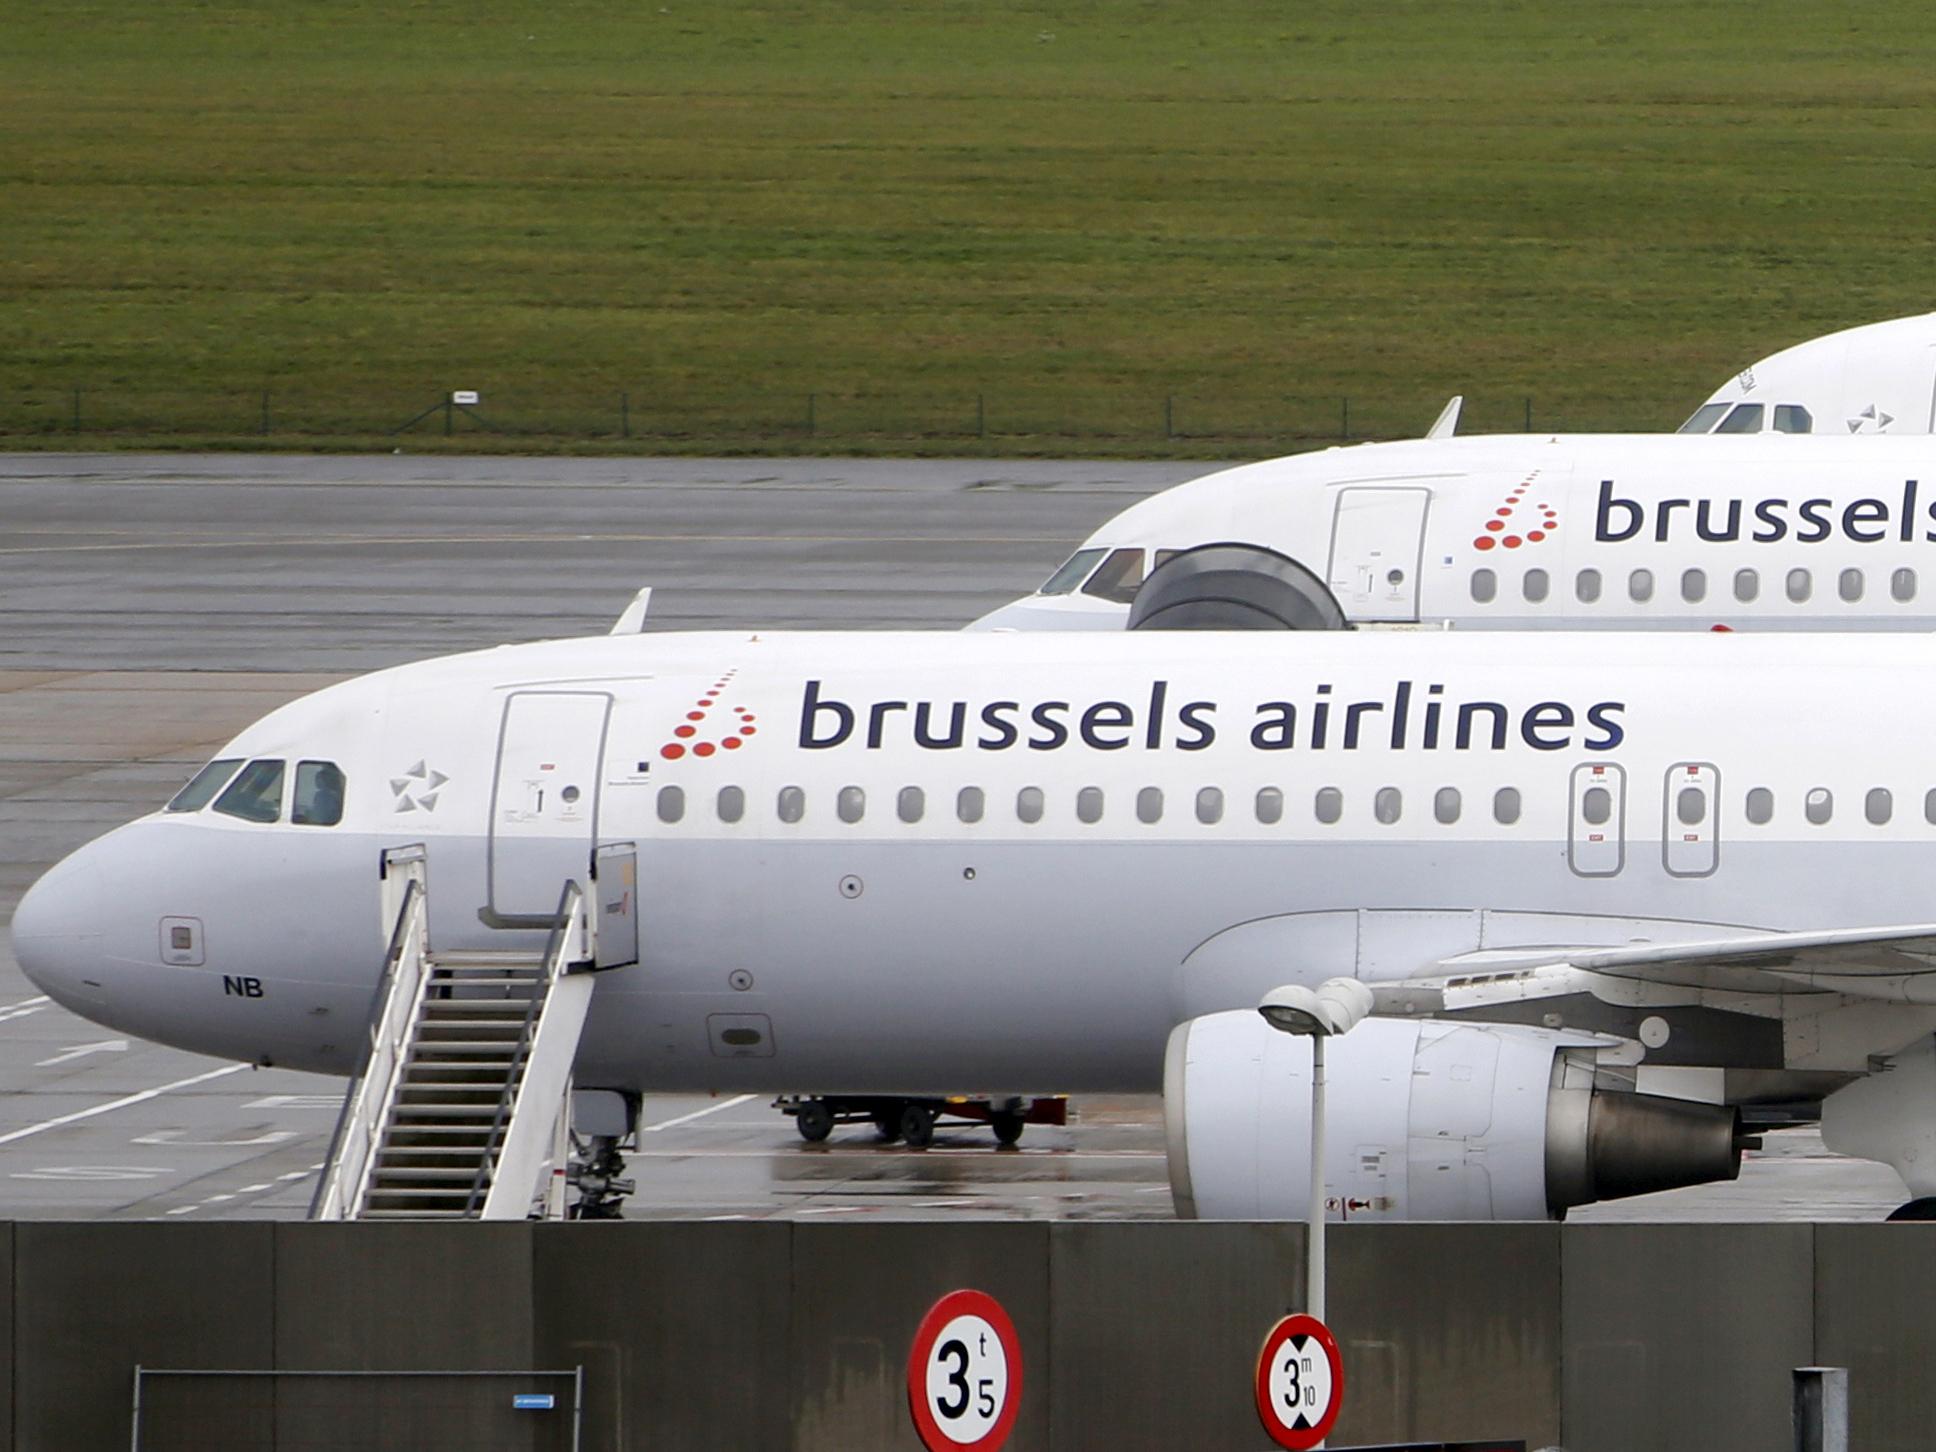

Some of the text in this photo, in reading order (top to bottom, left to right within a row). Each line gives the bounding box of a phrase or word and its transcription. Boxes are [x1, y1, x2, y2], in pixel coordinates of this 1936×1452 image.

[799, 681, 1624, 750] brussels airlines
[223, 974, 264, 998] NB
[936, 1332, 995, 1419] 3 t 5
[1284, 1358, 1316, 1407] 3 m 10
